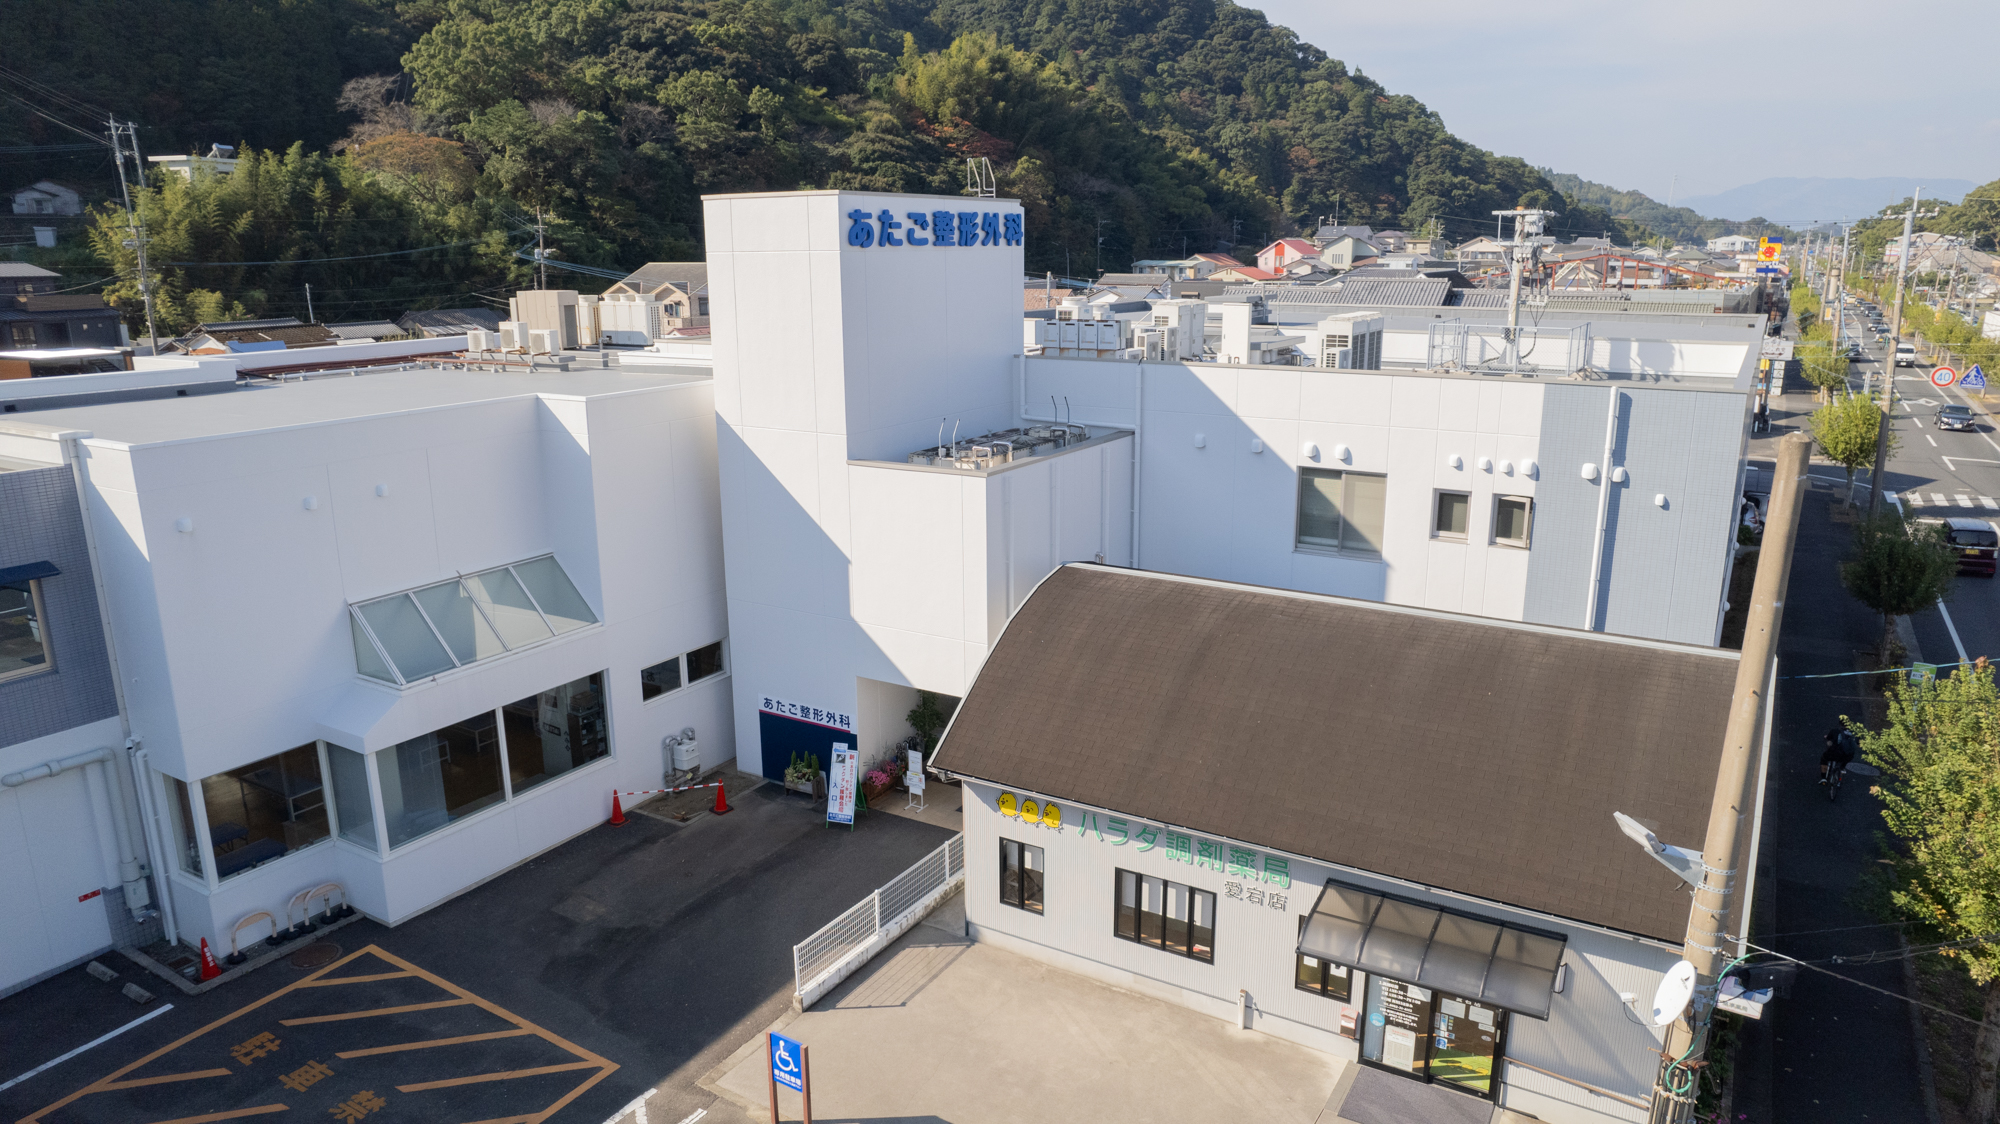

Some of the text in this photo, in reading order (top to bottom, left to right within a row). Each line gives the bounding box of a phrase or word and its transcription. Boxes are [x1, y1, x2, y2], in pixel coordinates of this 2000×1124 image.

[848, 208, 1023, 248] あたご整形外科
[1936, 372, 1951, 382] 40
[763, 697, 851, 728] あたご整形外科
[1077, 811, 1290, 888] ハラダ調剤薬局
[1224, 880, 1286, 911] 愛宕店
